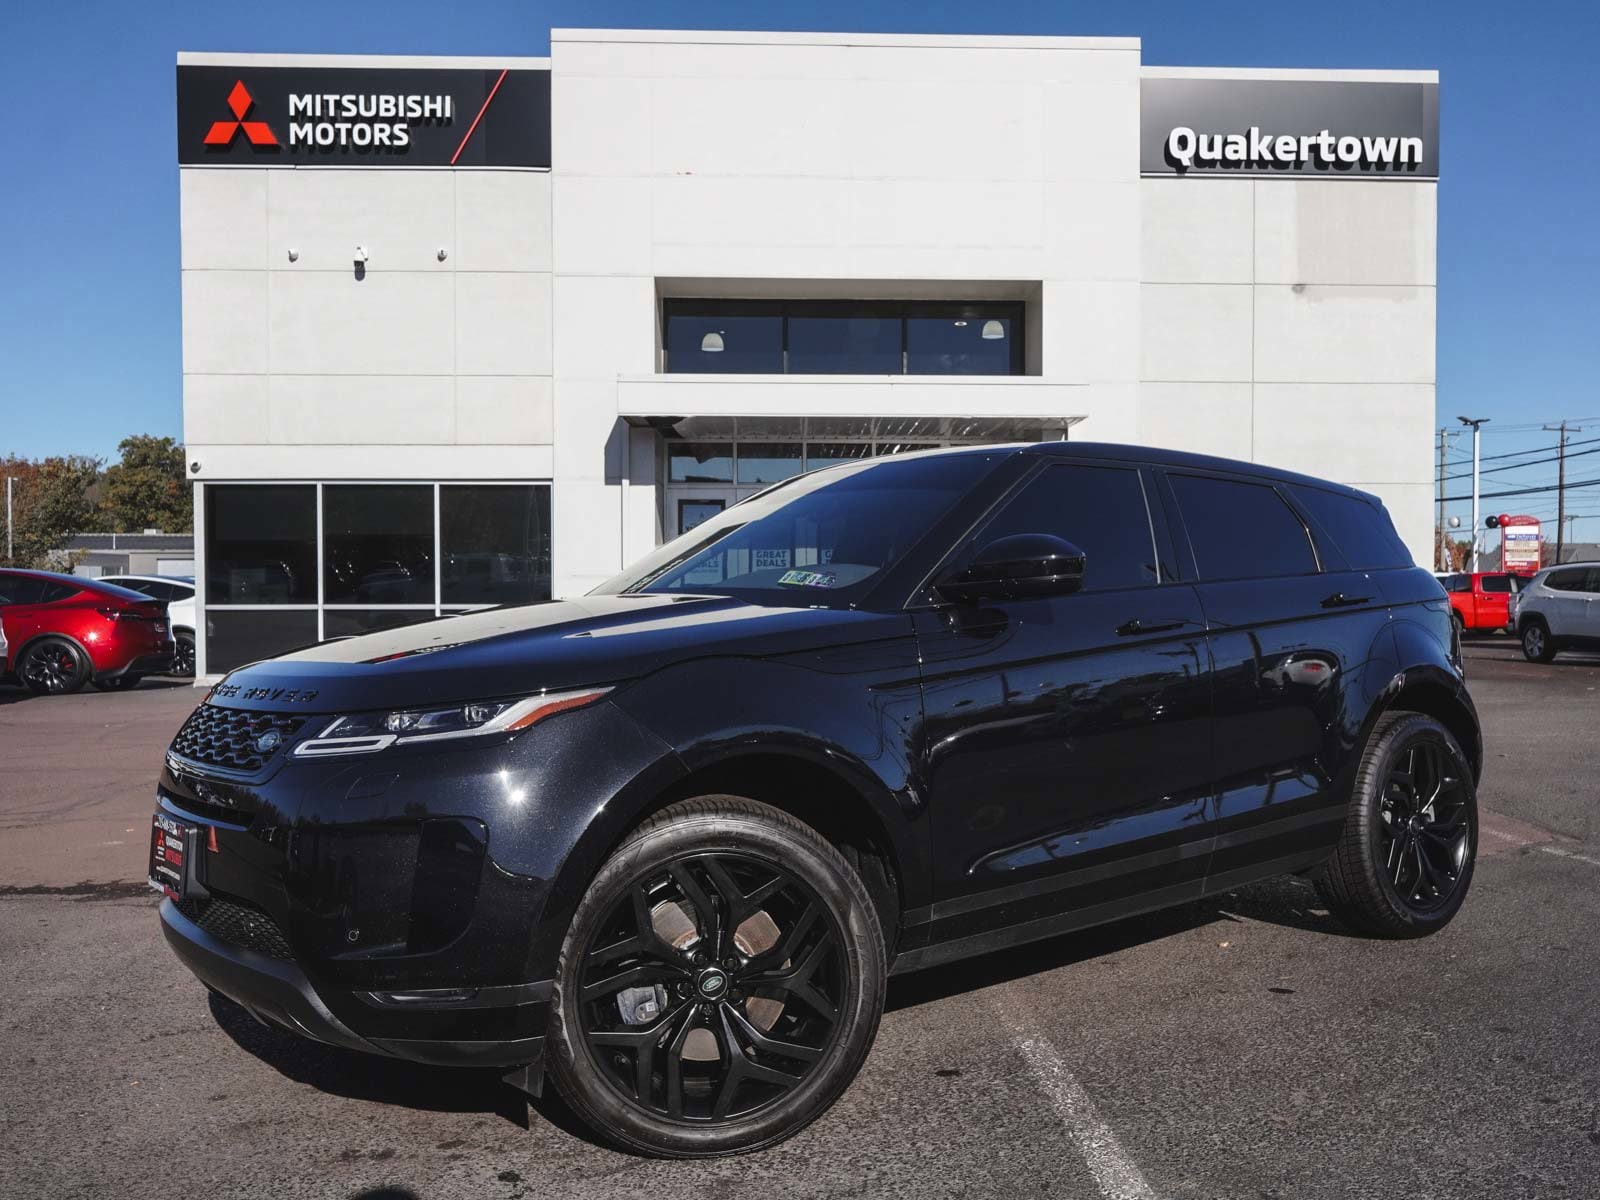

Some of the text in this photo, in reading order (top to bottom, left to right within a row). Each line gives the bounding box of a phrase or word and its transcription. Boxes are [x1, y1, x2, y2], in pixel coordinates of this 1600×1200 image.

[289, 93, 451, 118] MITSUBISHI
[289, 122, 409, 146] MOTORS
[1168, 127, 1423, 166] Quakertown
[756, 550, 786, 558] GREAT
[243, 687, 319, 703] ROVER
